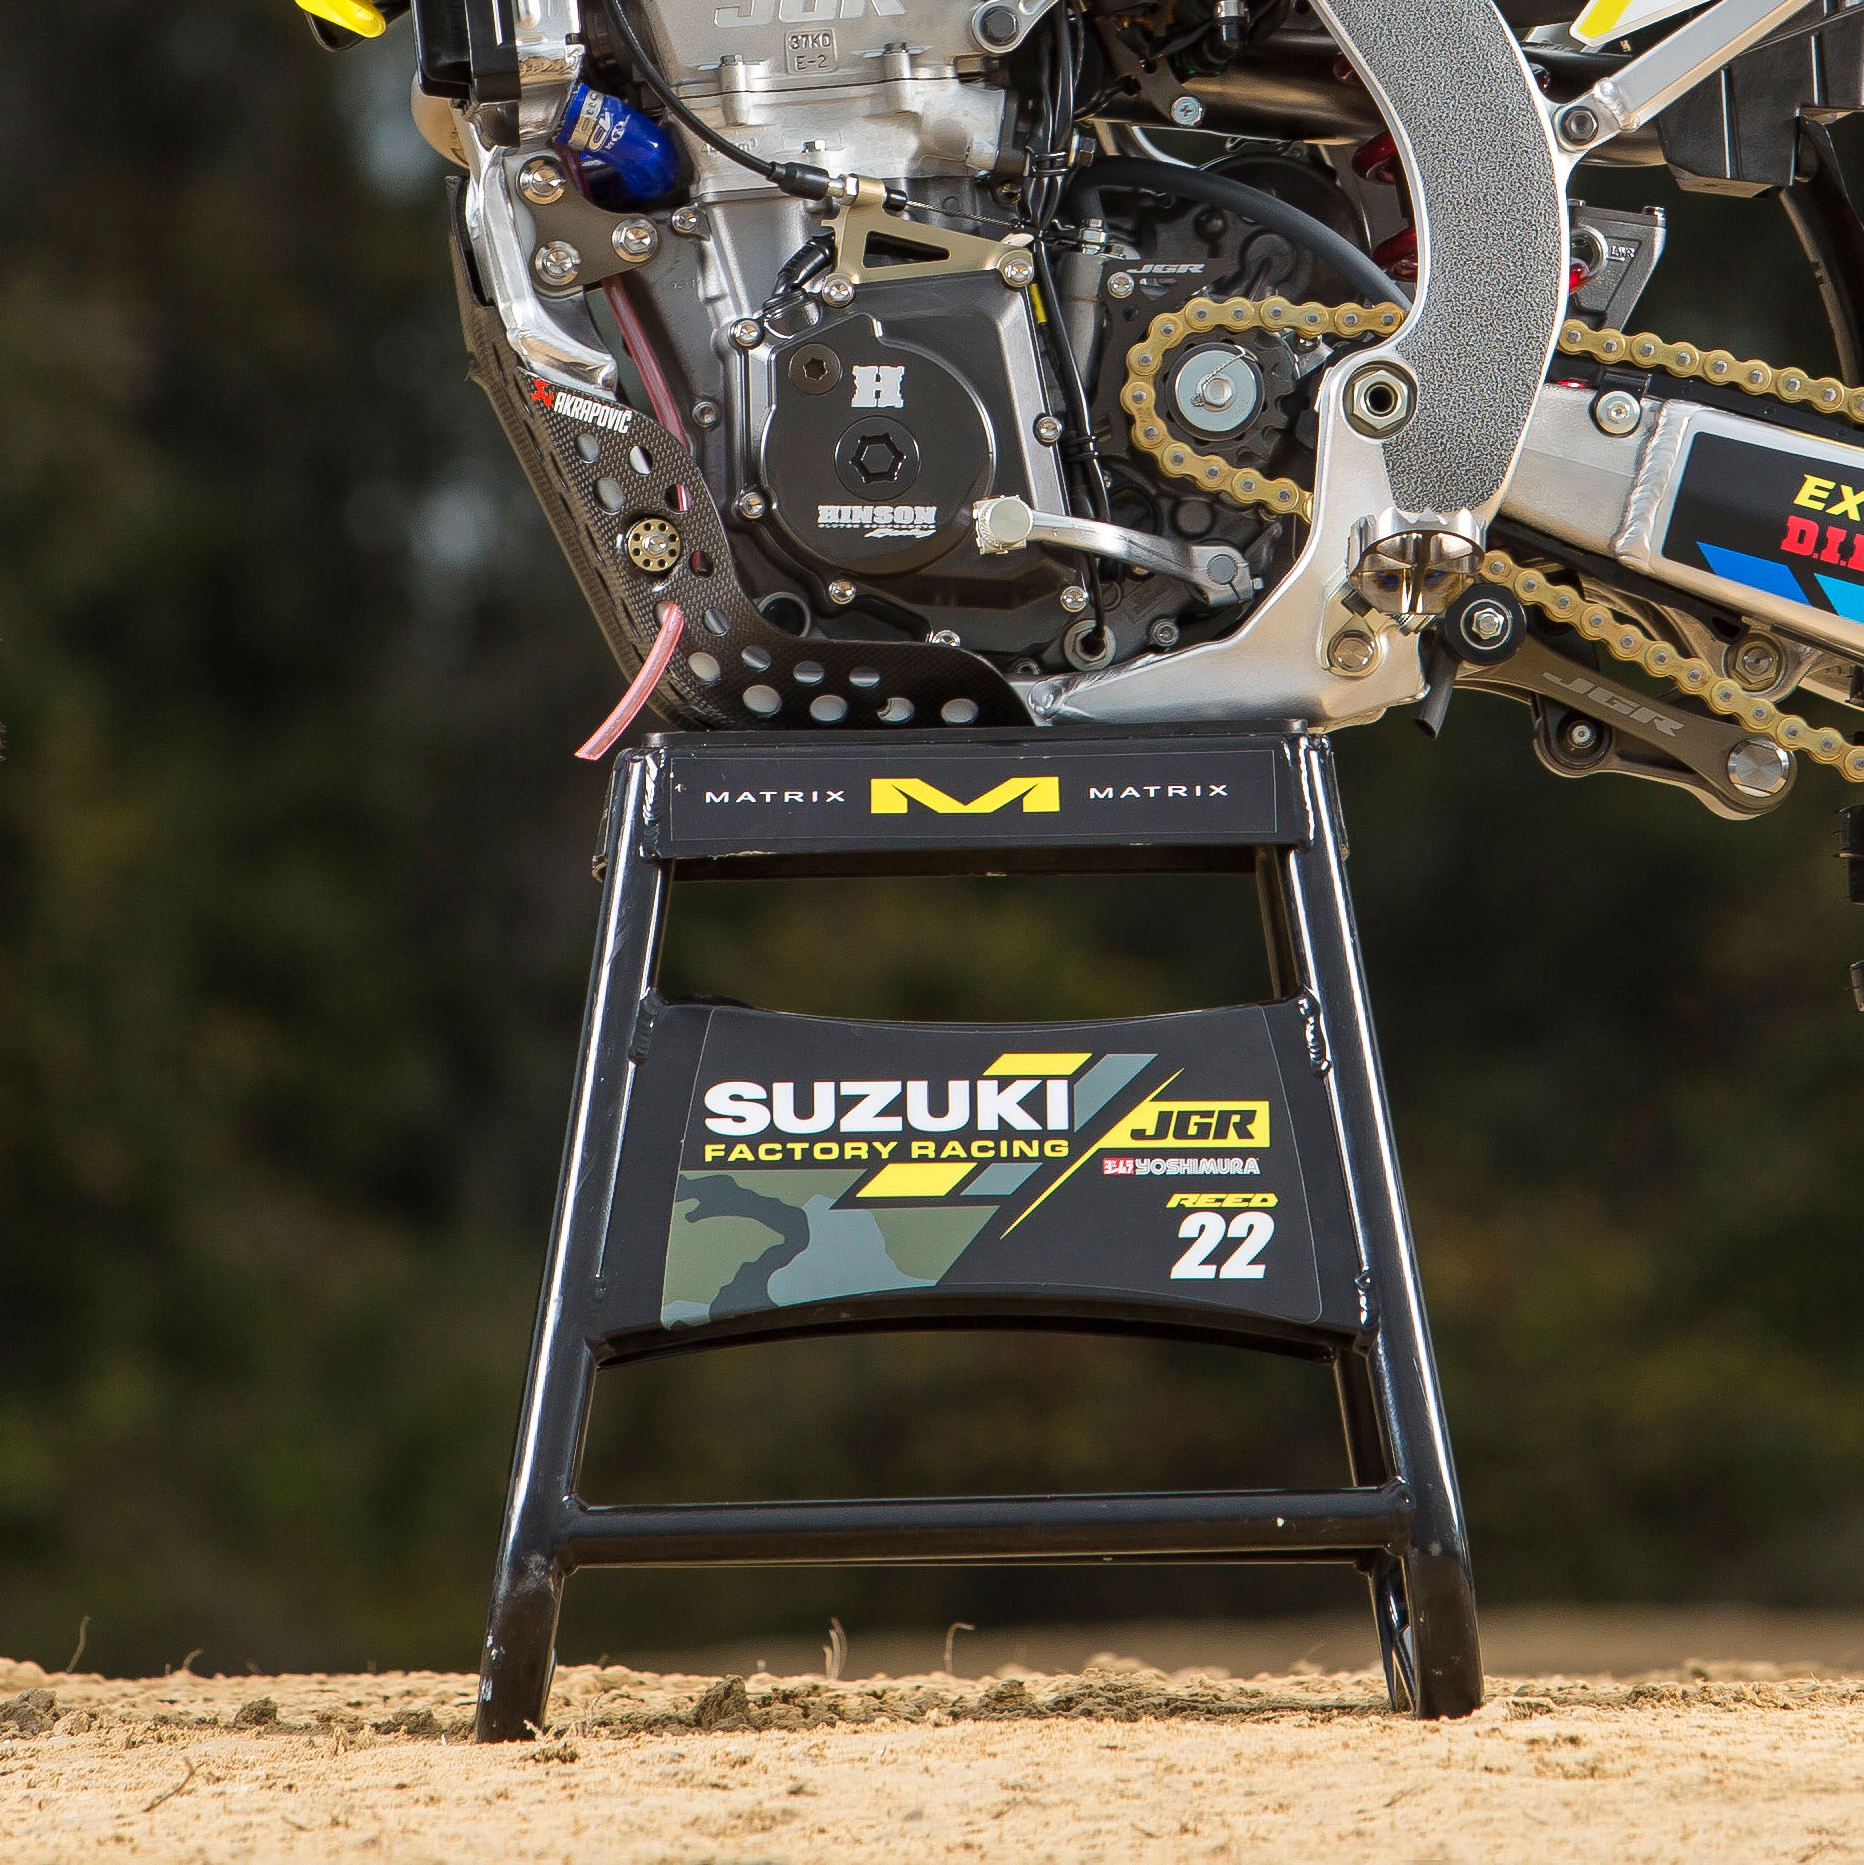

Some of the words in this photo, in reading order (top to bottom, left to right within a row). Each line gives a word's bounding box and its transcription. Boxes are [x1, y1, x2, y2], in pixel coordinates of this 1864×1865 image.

[795, 55, 829, 71] E-2
[1128, 263, 1207, 275] JGR
[817, 505, 937, 525] HINSON
[1541, 668, 1686, 738] JGR
[704, 789, 847, 804] MATRIX
[1088, 783, 1230, 800] MATRIX
[703, 1079, 1071, 1136] SUZUKI
[1129, 1105, 1263, 1142] JGR
[703, 1140, 898, 1163] FACTORY
[909, 1138, 1070, 1161] RACING
[1134, 1157, 1261, 1175] YOSHIMURA
[1165, 1193, 1280, 1208] REED
[1169, 1211, 1278, 1279] 22
